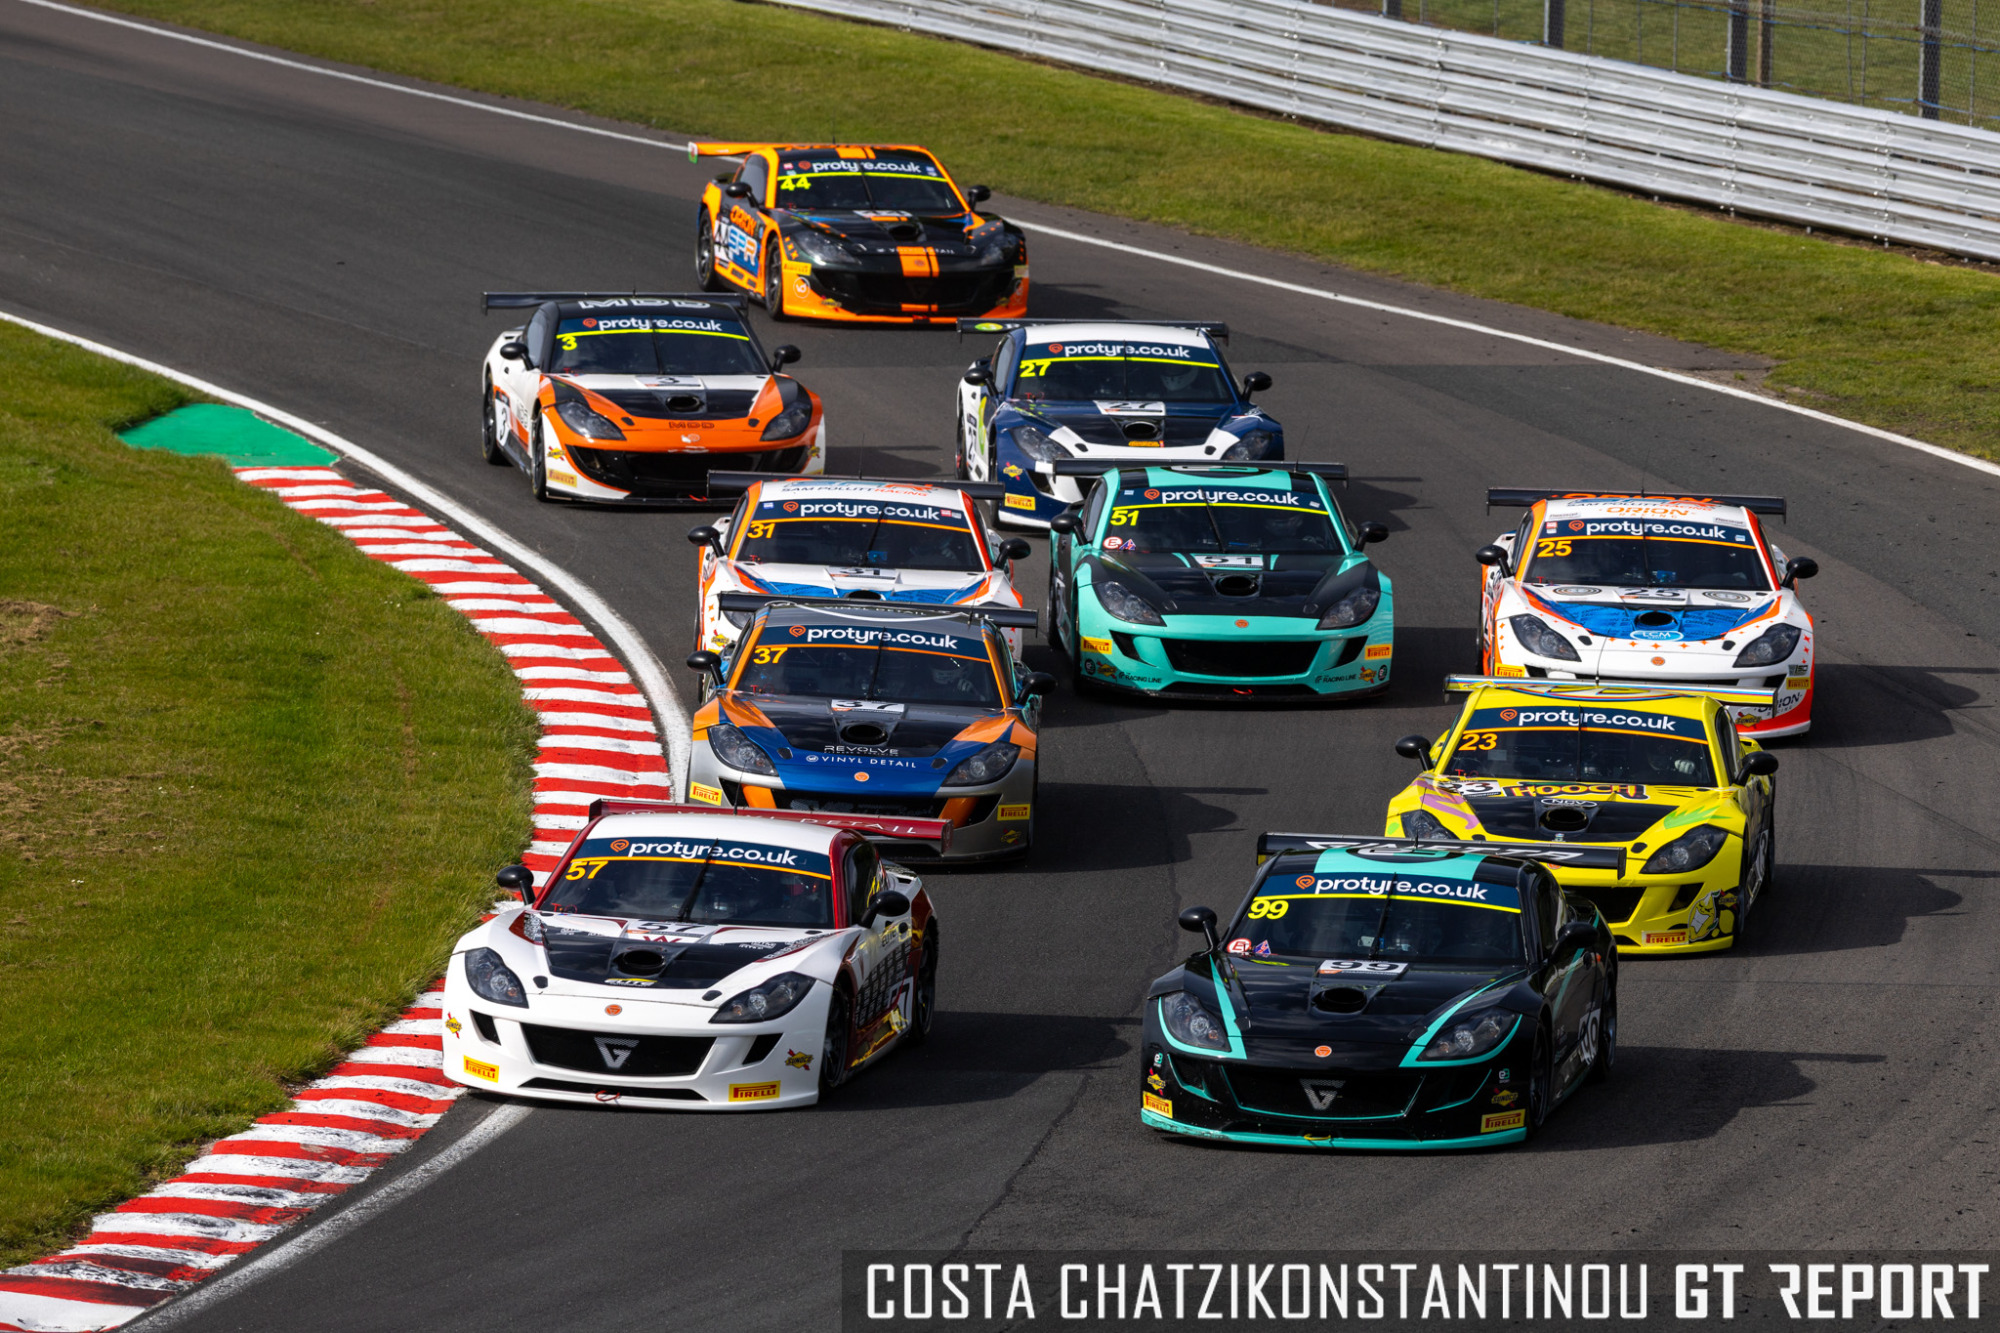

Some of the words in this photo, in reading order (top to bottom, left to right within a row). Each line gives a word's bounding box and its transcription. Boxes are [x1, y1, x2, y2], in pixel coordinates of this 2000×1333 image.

[780, 177, 811, 191] 44
[561, 335, 578, 351] 3
[1064, 343, 1191, 358] protyre.co.uk
[1019, 361, 1052, 378] 27
[1162, 489, 1300, 506] protyre.co.uk
[800, 501, 940, 521] protyre.co.uk
[1110, 510, 1139, 526] 51
[1606, 507, 1688, 516] ORION
[747, 523, 776, 539] 31
[1586, 520, 1726, 540] protyre.co.uk
[1536, 541, 1573, 558] 25
[806, 626, 958, 650] protyre.co.uk
[753, 647, 788, 664] 37
[1518, 708, 1677, 732] protyre.co.uk
[824, 745, 899, 755] REVOLVE
[1458, 733, 1498, 751] 23
[822, 756, 863, 764] VINYL
[870, 758, 916, 768] DETAIL
[692, 785, 719, 802] PIRELLI
[1510, 783, 1637, 797] HOOCH
[1000, 806, 1027, 817] PIRELLI
[800, 818, 917, 835] DETAIL
[627, 841, 799, 866] protyre.co.uk
[565, 860, 609, 881] 57
[1314, 875, 1489, 900] protyre.co.uk
[1247, 900, 1289, 920] 99
[637, 922, 705, 932] 57
[1646, 932, 1686, 944] PIRELLI
[1330, 961, 1400, 972] 99
[465, 1059, 496, 1079] PIRELLI
[733, 1084, 777, 1099] PIRELLI
[1145, 1095, 1169, 1114] PIRELLI
[1485, 1112, 1521, 1129] PIRELLI
